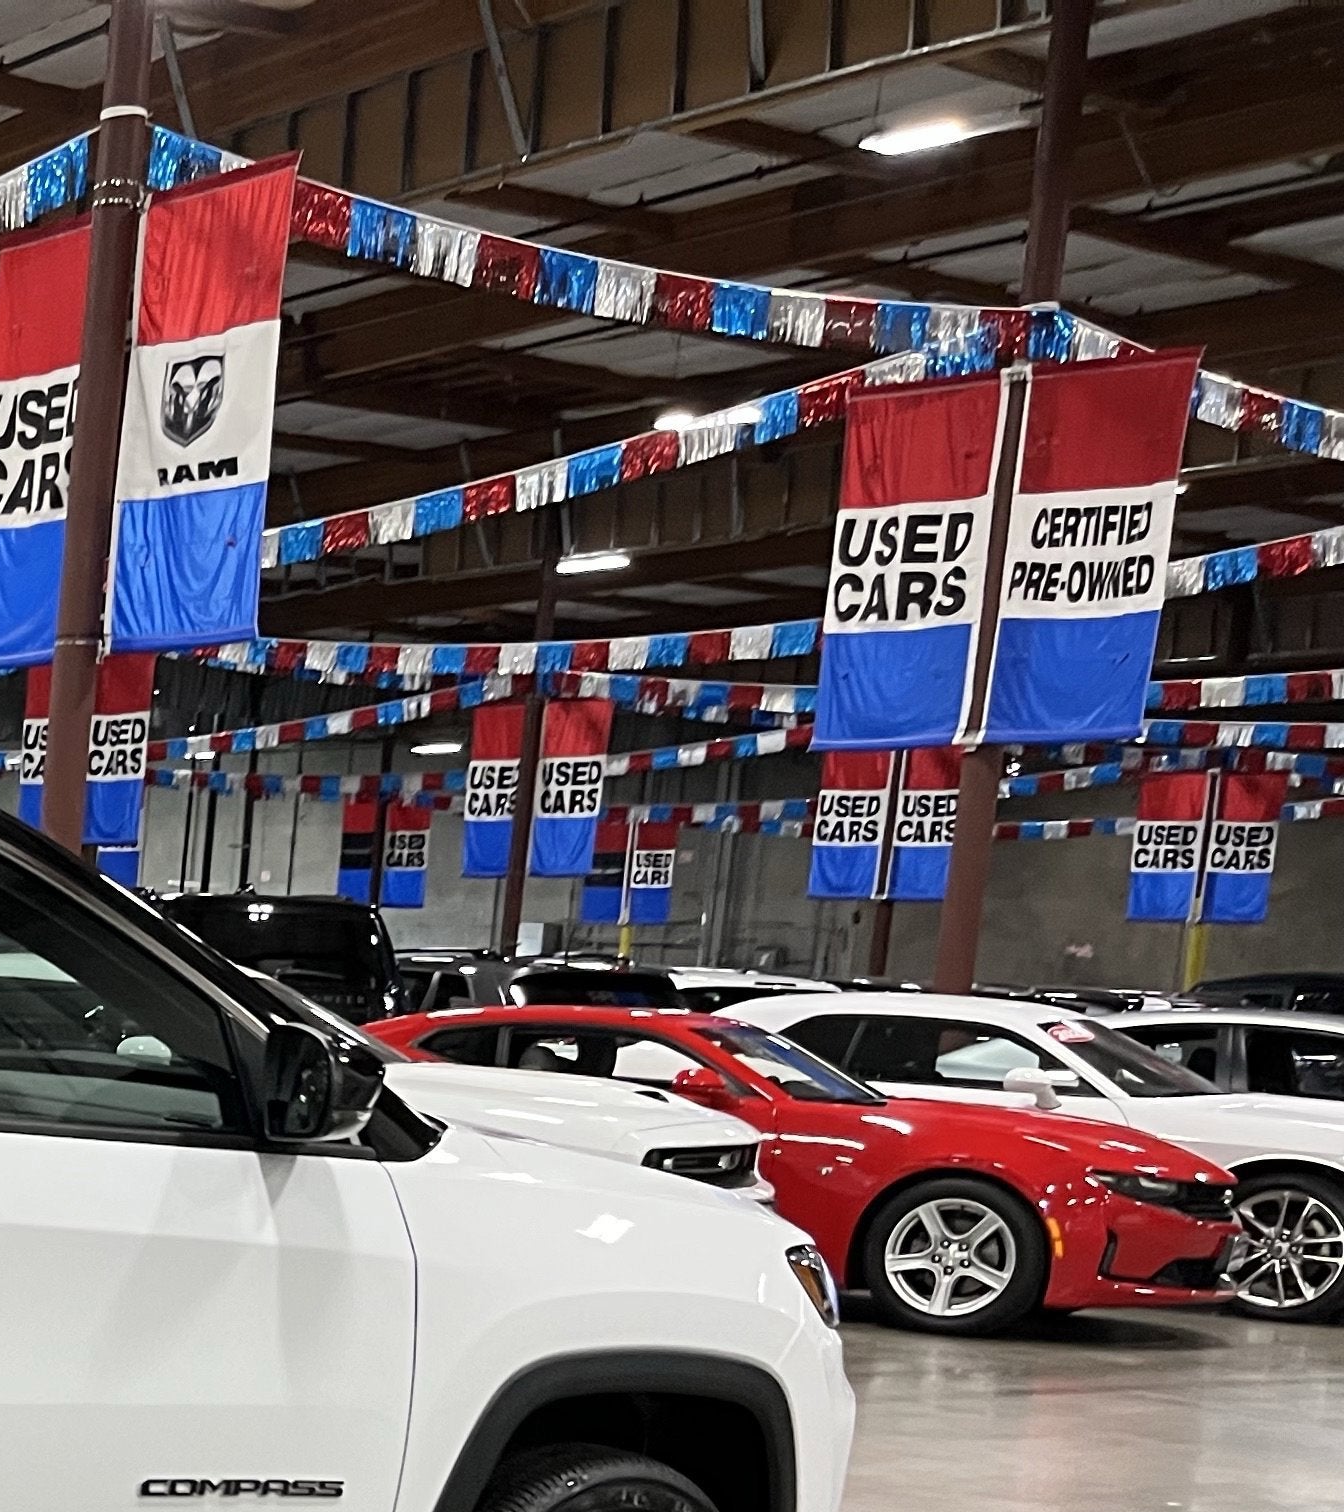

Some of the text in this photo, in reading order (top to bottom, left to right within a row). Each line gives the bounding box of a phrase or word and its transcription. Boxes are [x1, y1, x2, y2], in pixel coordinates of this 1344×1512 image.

[1030, 502, 1153, 549] CERTIFIED
[838, 511, 975, 567] USED
[1008, 554, 1155, 603] PRE-OWNED
[833, 566, 968, 623] CARS
[92, 718, 146, 747] USED
[88, 748, 143, 775] CARS
[542, 761, 602, 787] USED
[540, 788, 599, 814] CARS
[820, 795, 880, 817] USED
[817, 820, 879, 842] CARS
[1137, 825, 1198, 846] USED
[1215, 825, 1274, 847] USED
[1134, 848, 1194, 869] CARS
[1211, 848, 1271, 870] CARS
[139, 1479, 344, 1498] COMPASS
